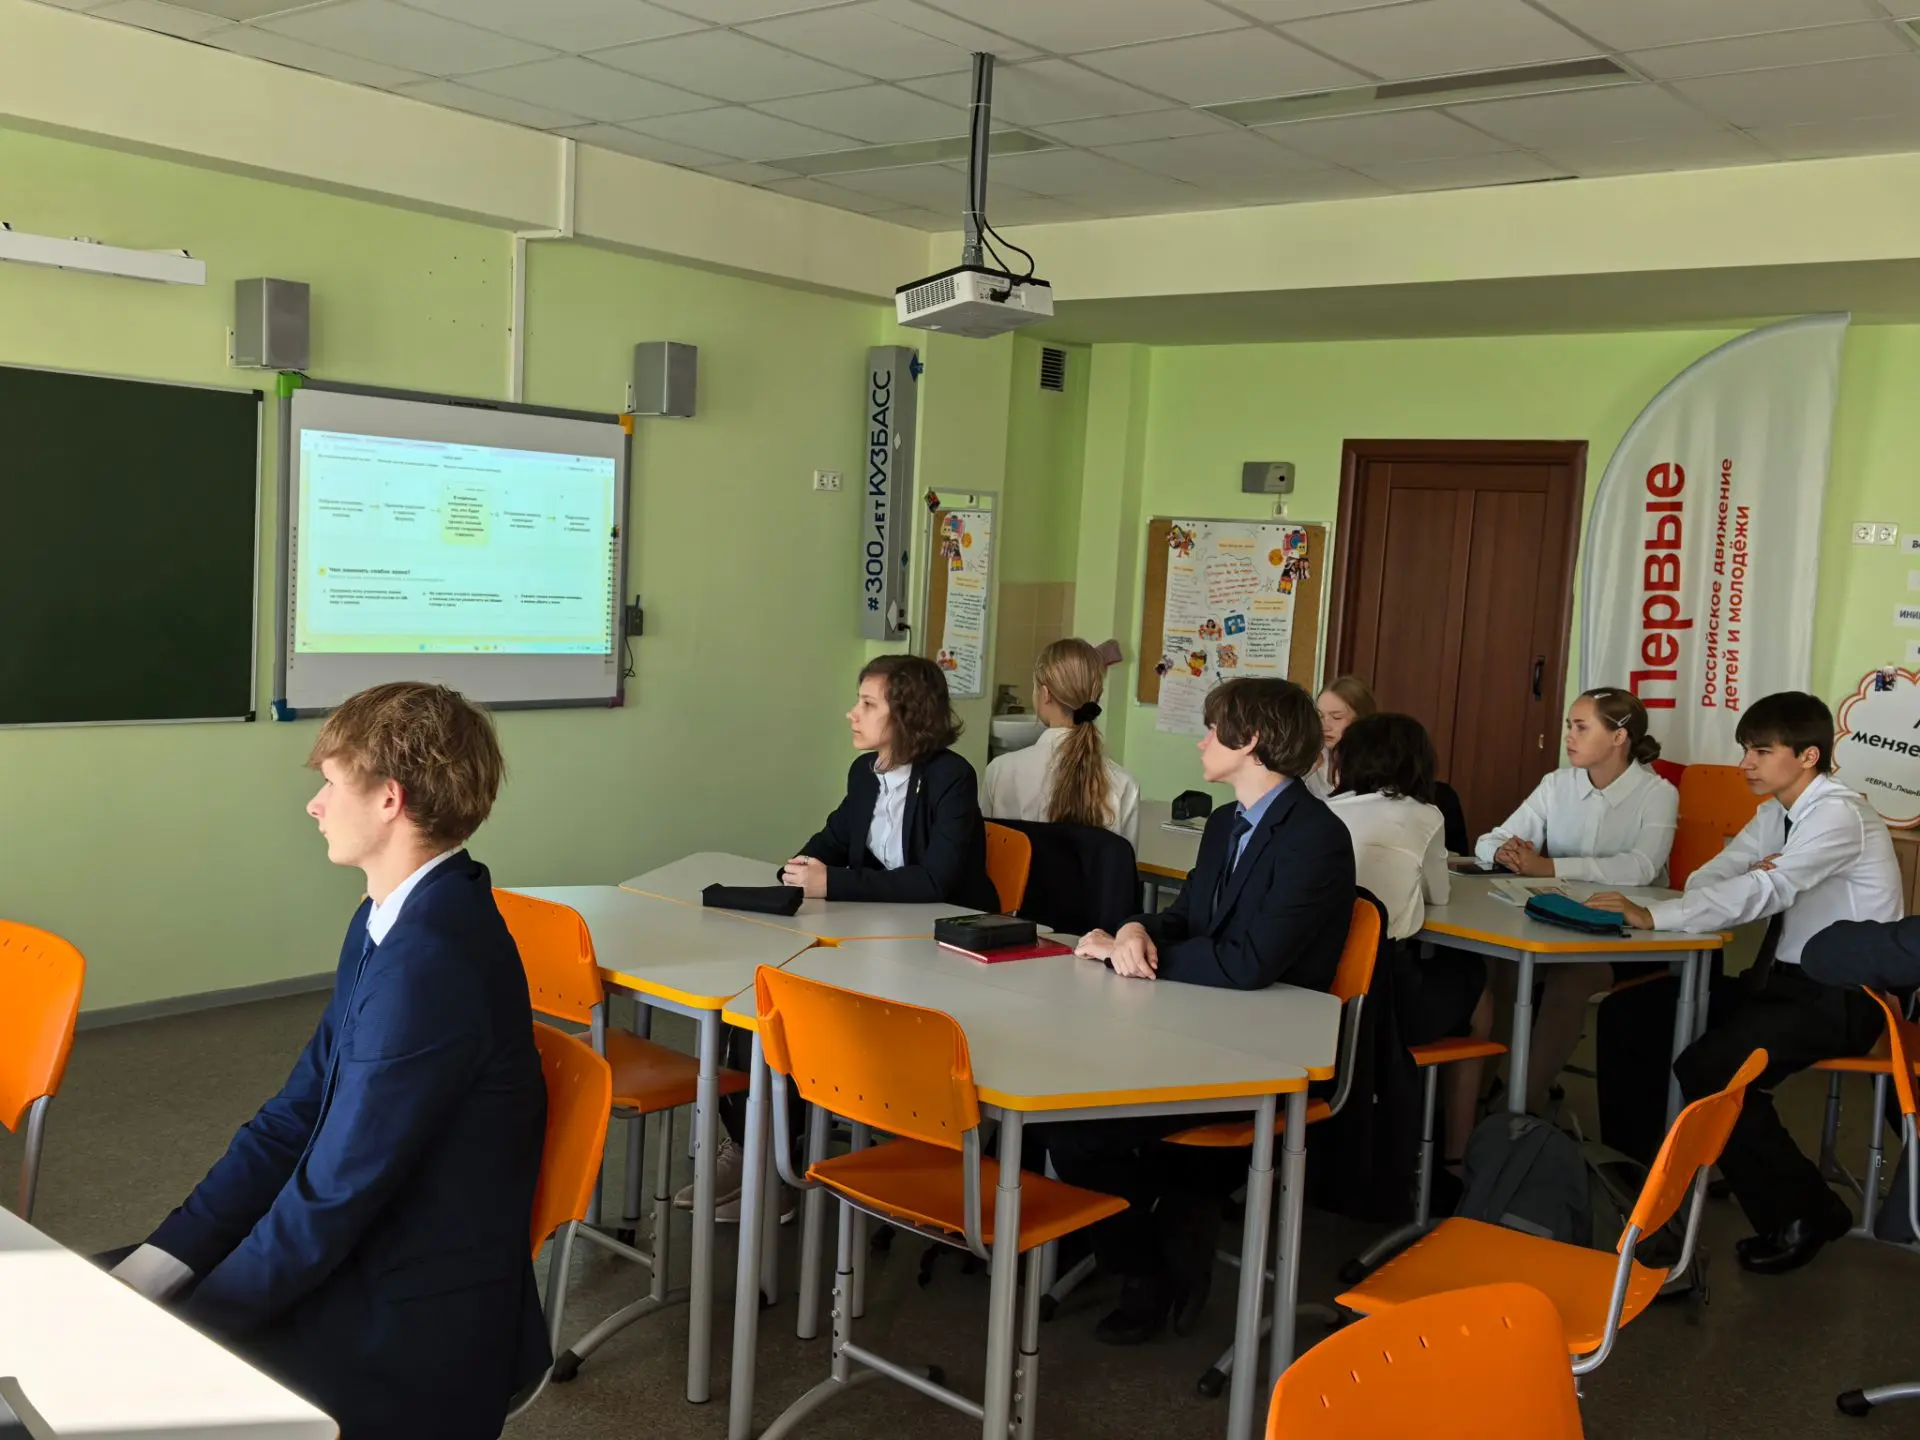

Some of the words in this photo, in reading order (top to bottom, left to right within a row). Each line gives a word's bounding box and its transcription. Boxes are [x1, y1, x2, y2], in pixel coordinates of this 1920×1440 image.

[1711, 458, 1732, 575] движение
[1727, 506, 1750, 623] молодёжи
[1629, 462, 1693, 709] Первые
[1701, 580, 1723, 708] Российское
[1727, 630, 1740, 643] и
[1723, 649, 1740, 711] детей
[1851, 730, 1920, 758] меняе
